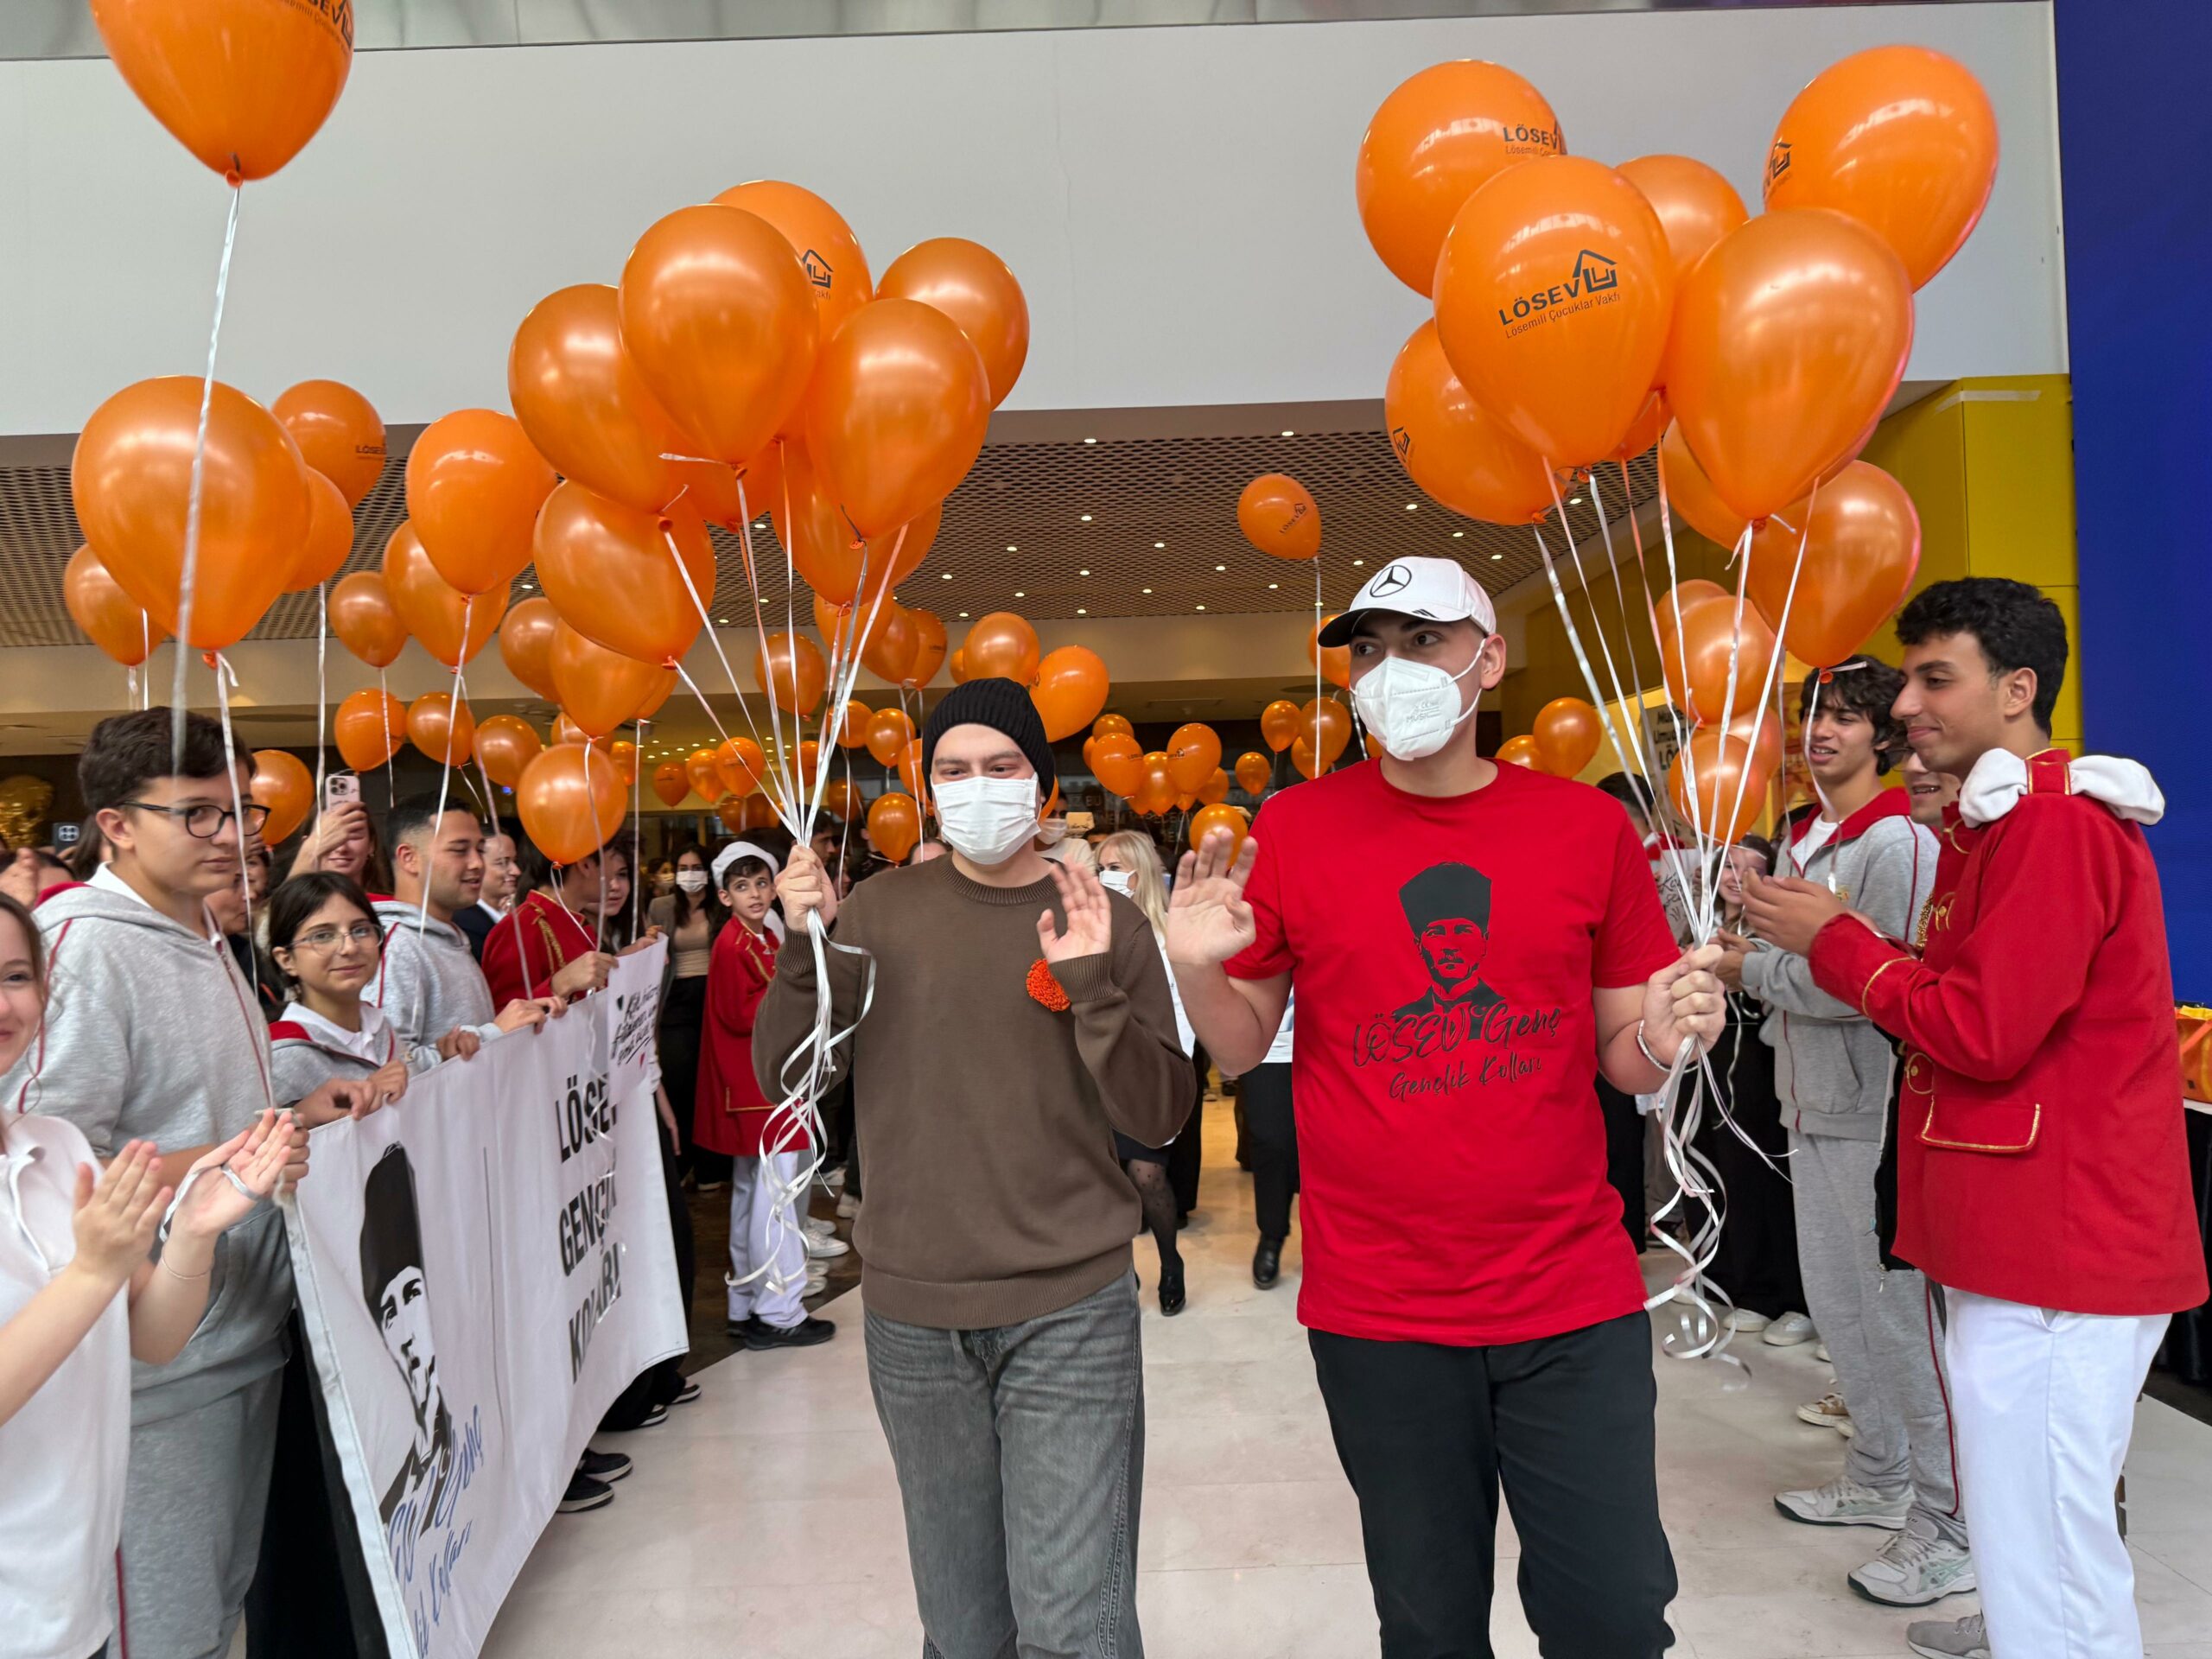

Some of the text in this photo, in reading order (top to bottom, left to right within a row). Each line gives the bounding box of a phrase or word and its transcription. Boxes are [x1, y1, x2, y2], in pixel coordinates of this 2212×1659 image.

[1503, 124, 1557, 150] LÖSEV
[1498, 277, 1580, 326] LÖSEV
[1484, 1002, 1561, 1050] Genç
[1389, 1051, 1542, 1102] Gençlik Kolları
[556, 1072, 618, 1164] LÖSE
